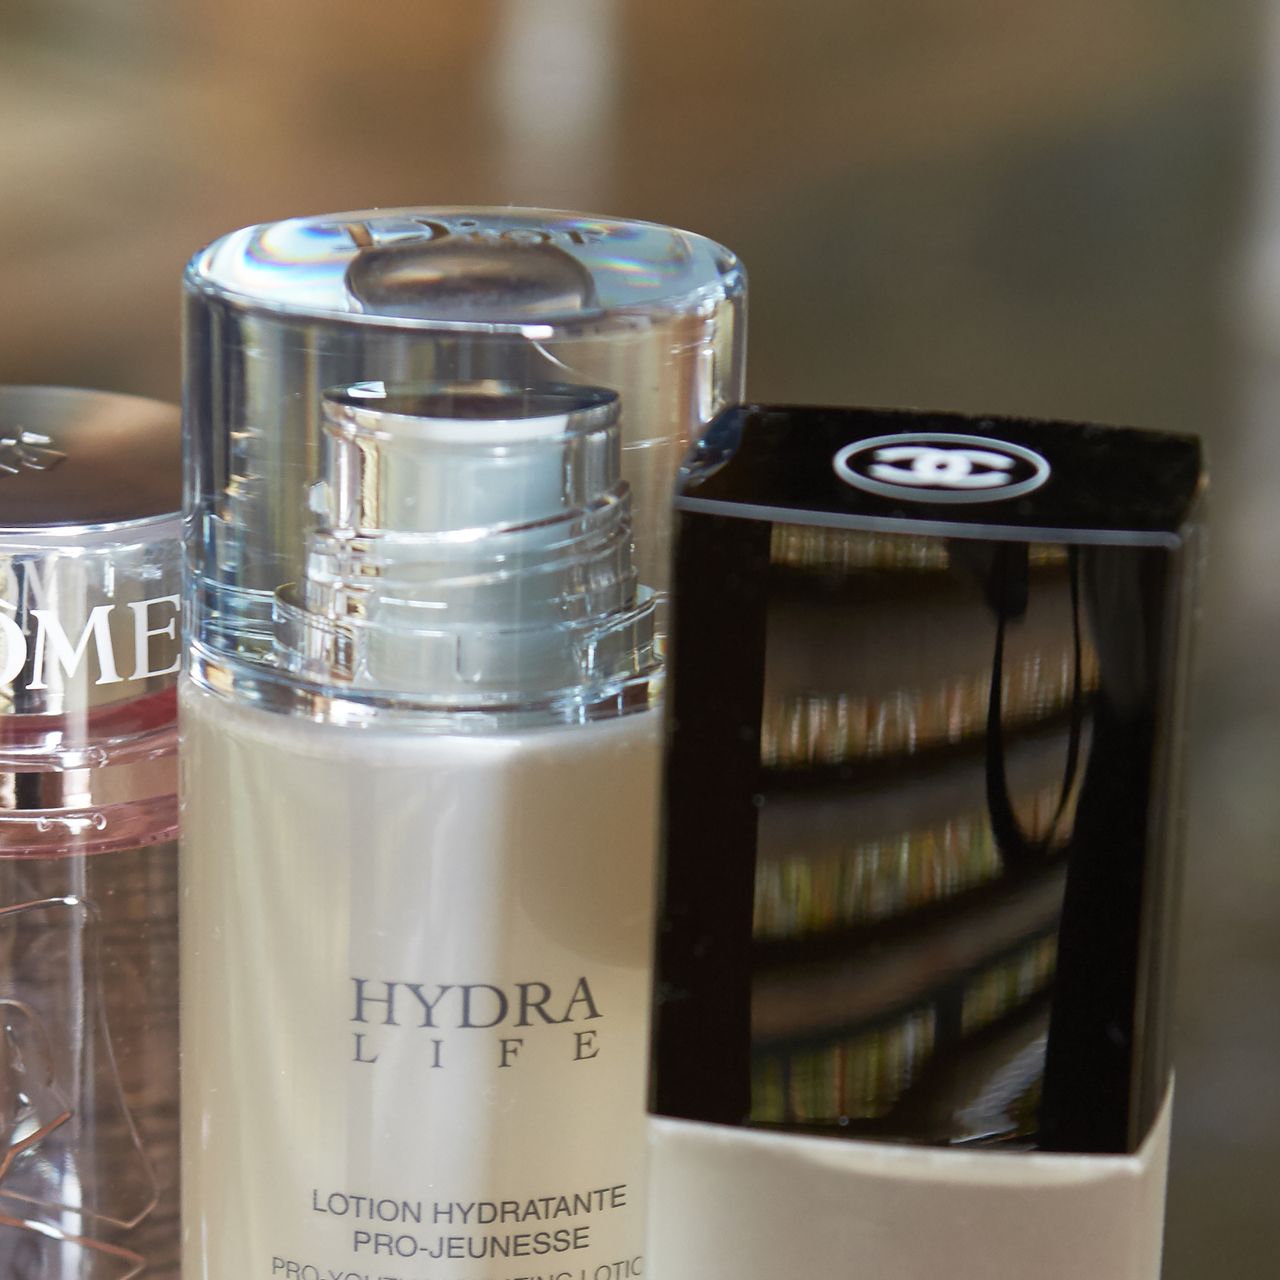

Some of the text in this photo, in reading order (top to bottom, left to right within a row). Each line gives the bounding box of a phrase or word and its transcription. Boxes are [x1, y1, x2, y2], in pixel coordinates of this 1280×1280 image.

[349, 976, 604, 1030] HYDRA
[312, 1184, 627, 1225] LOTION HYDRATANTE
[352, 1226, 591, 1260] PRO-JEUNESSE
